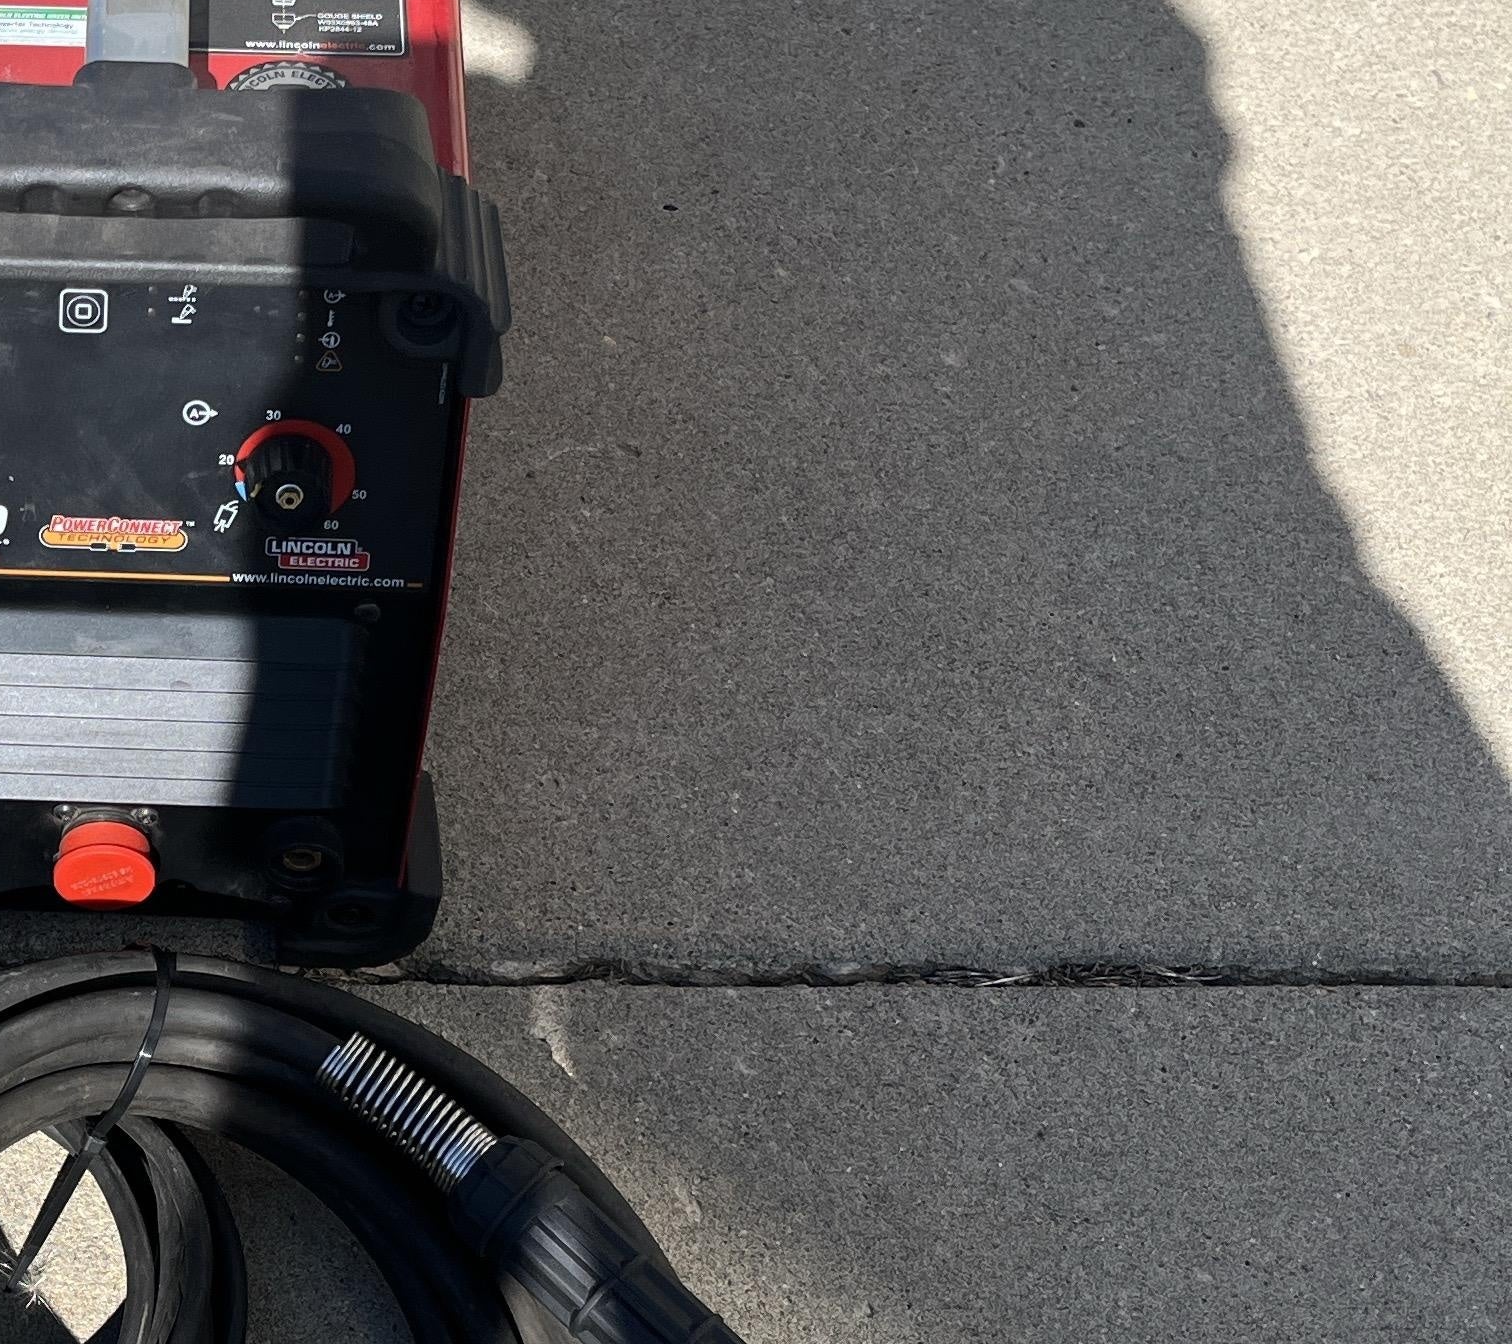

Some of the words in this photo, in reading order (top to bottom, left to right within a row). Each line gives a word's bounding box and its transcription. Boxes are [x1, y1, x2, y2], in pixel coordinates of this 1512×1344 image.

[266, 410, 281, 420] 30
[336, 424, 352, 434] 40
[218, 454, 234, 465] 20
[351, 490, 367, 500] 50
[323, 520, 339, 530] 60
[59, 534, 171, 545] TECHNOLOGY
[271, 540, 352, 555] LINCOLN
[290, 556, 360, 568] ELECTRIC
[232, 573, 405, 588] www.lincolnelectric.com
